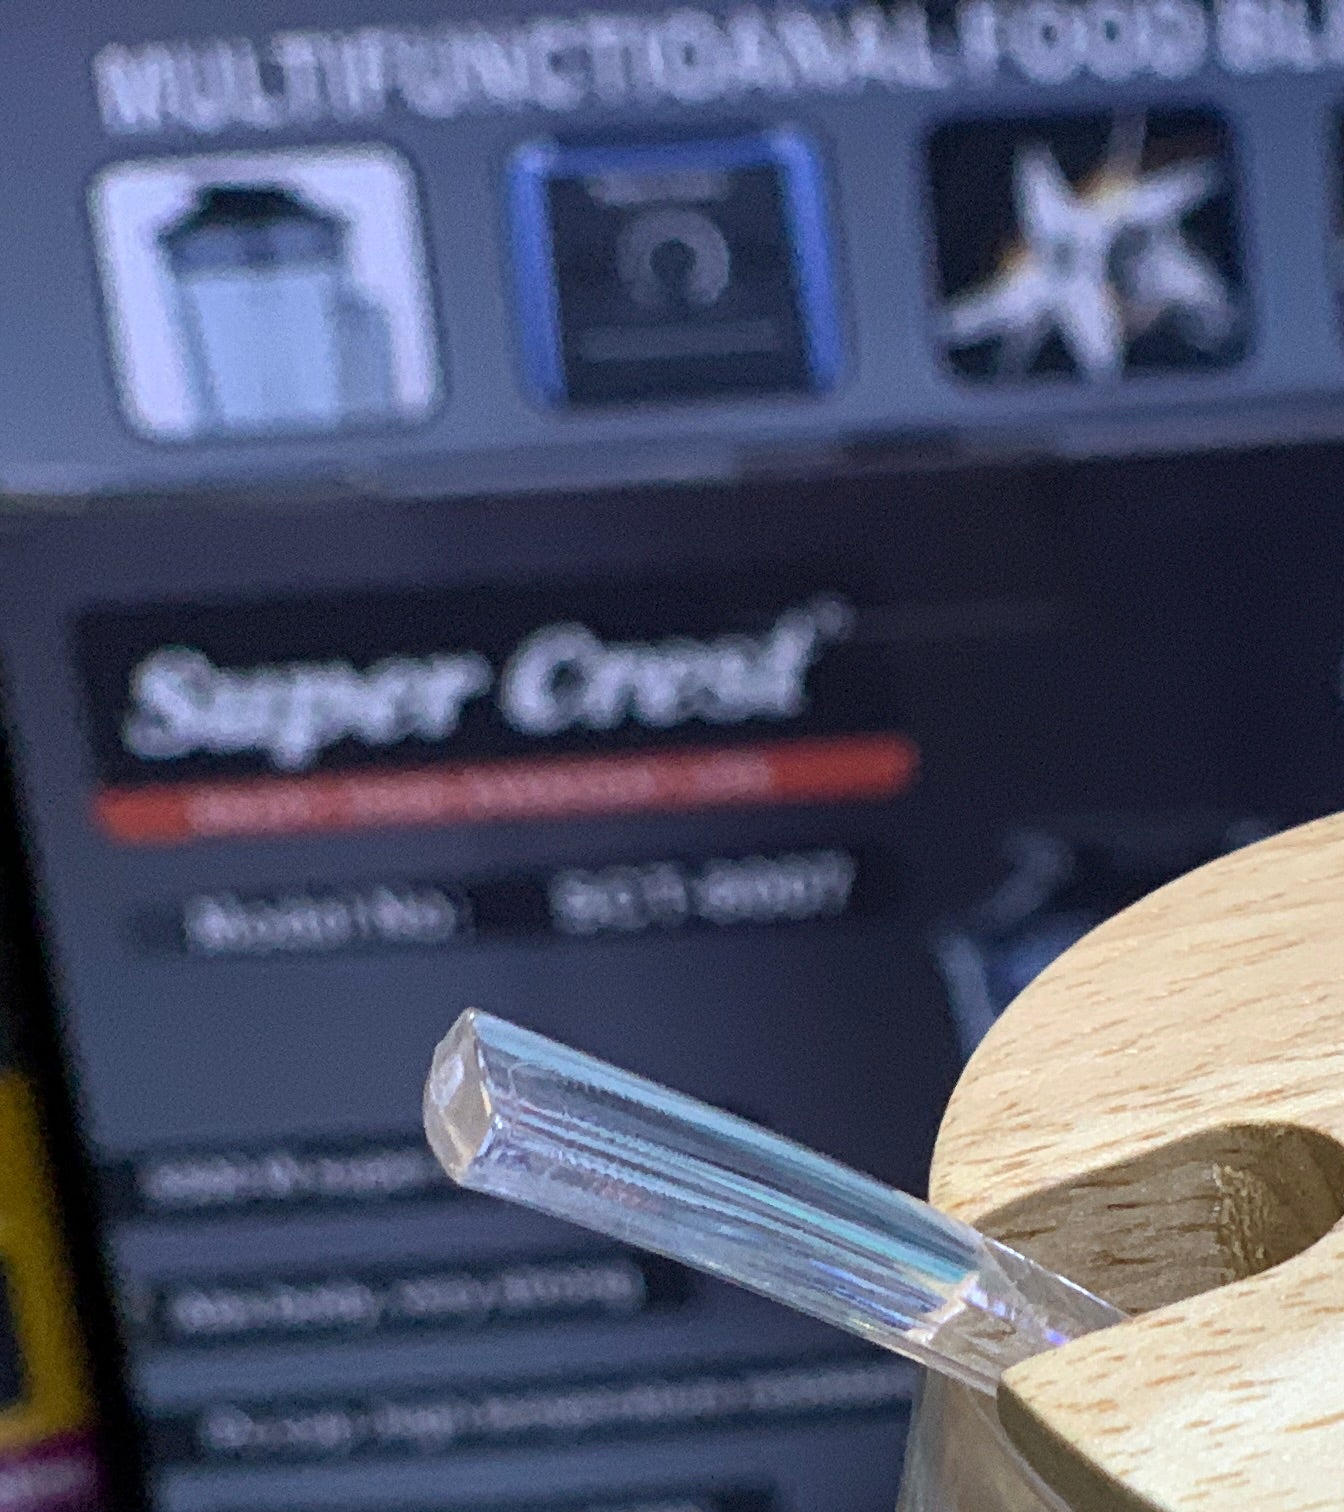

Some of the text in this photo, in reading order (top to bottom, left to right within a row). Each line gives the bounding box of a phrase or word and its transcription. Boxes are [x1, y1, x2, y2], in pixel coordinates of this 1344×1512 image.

[962, 0, 1203, 83] FOOD
[123, 602, 826, 770] Super Crest
